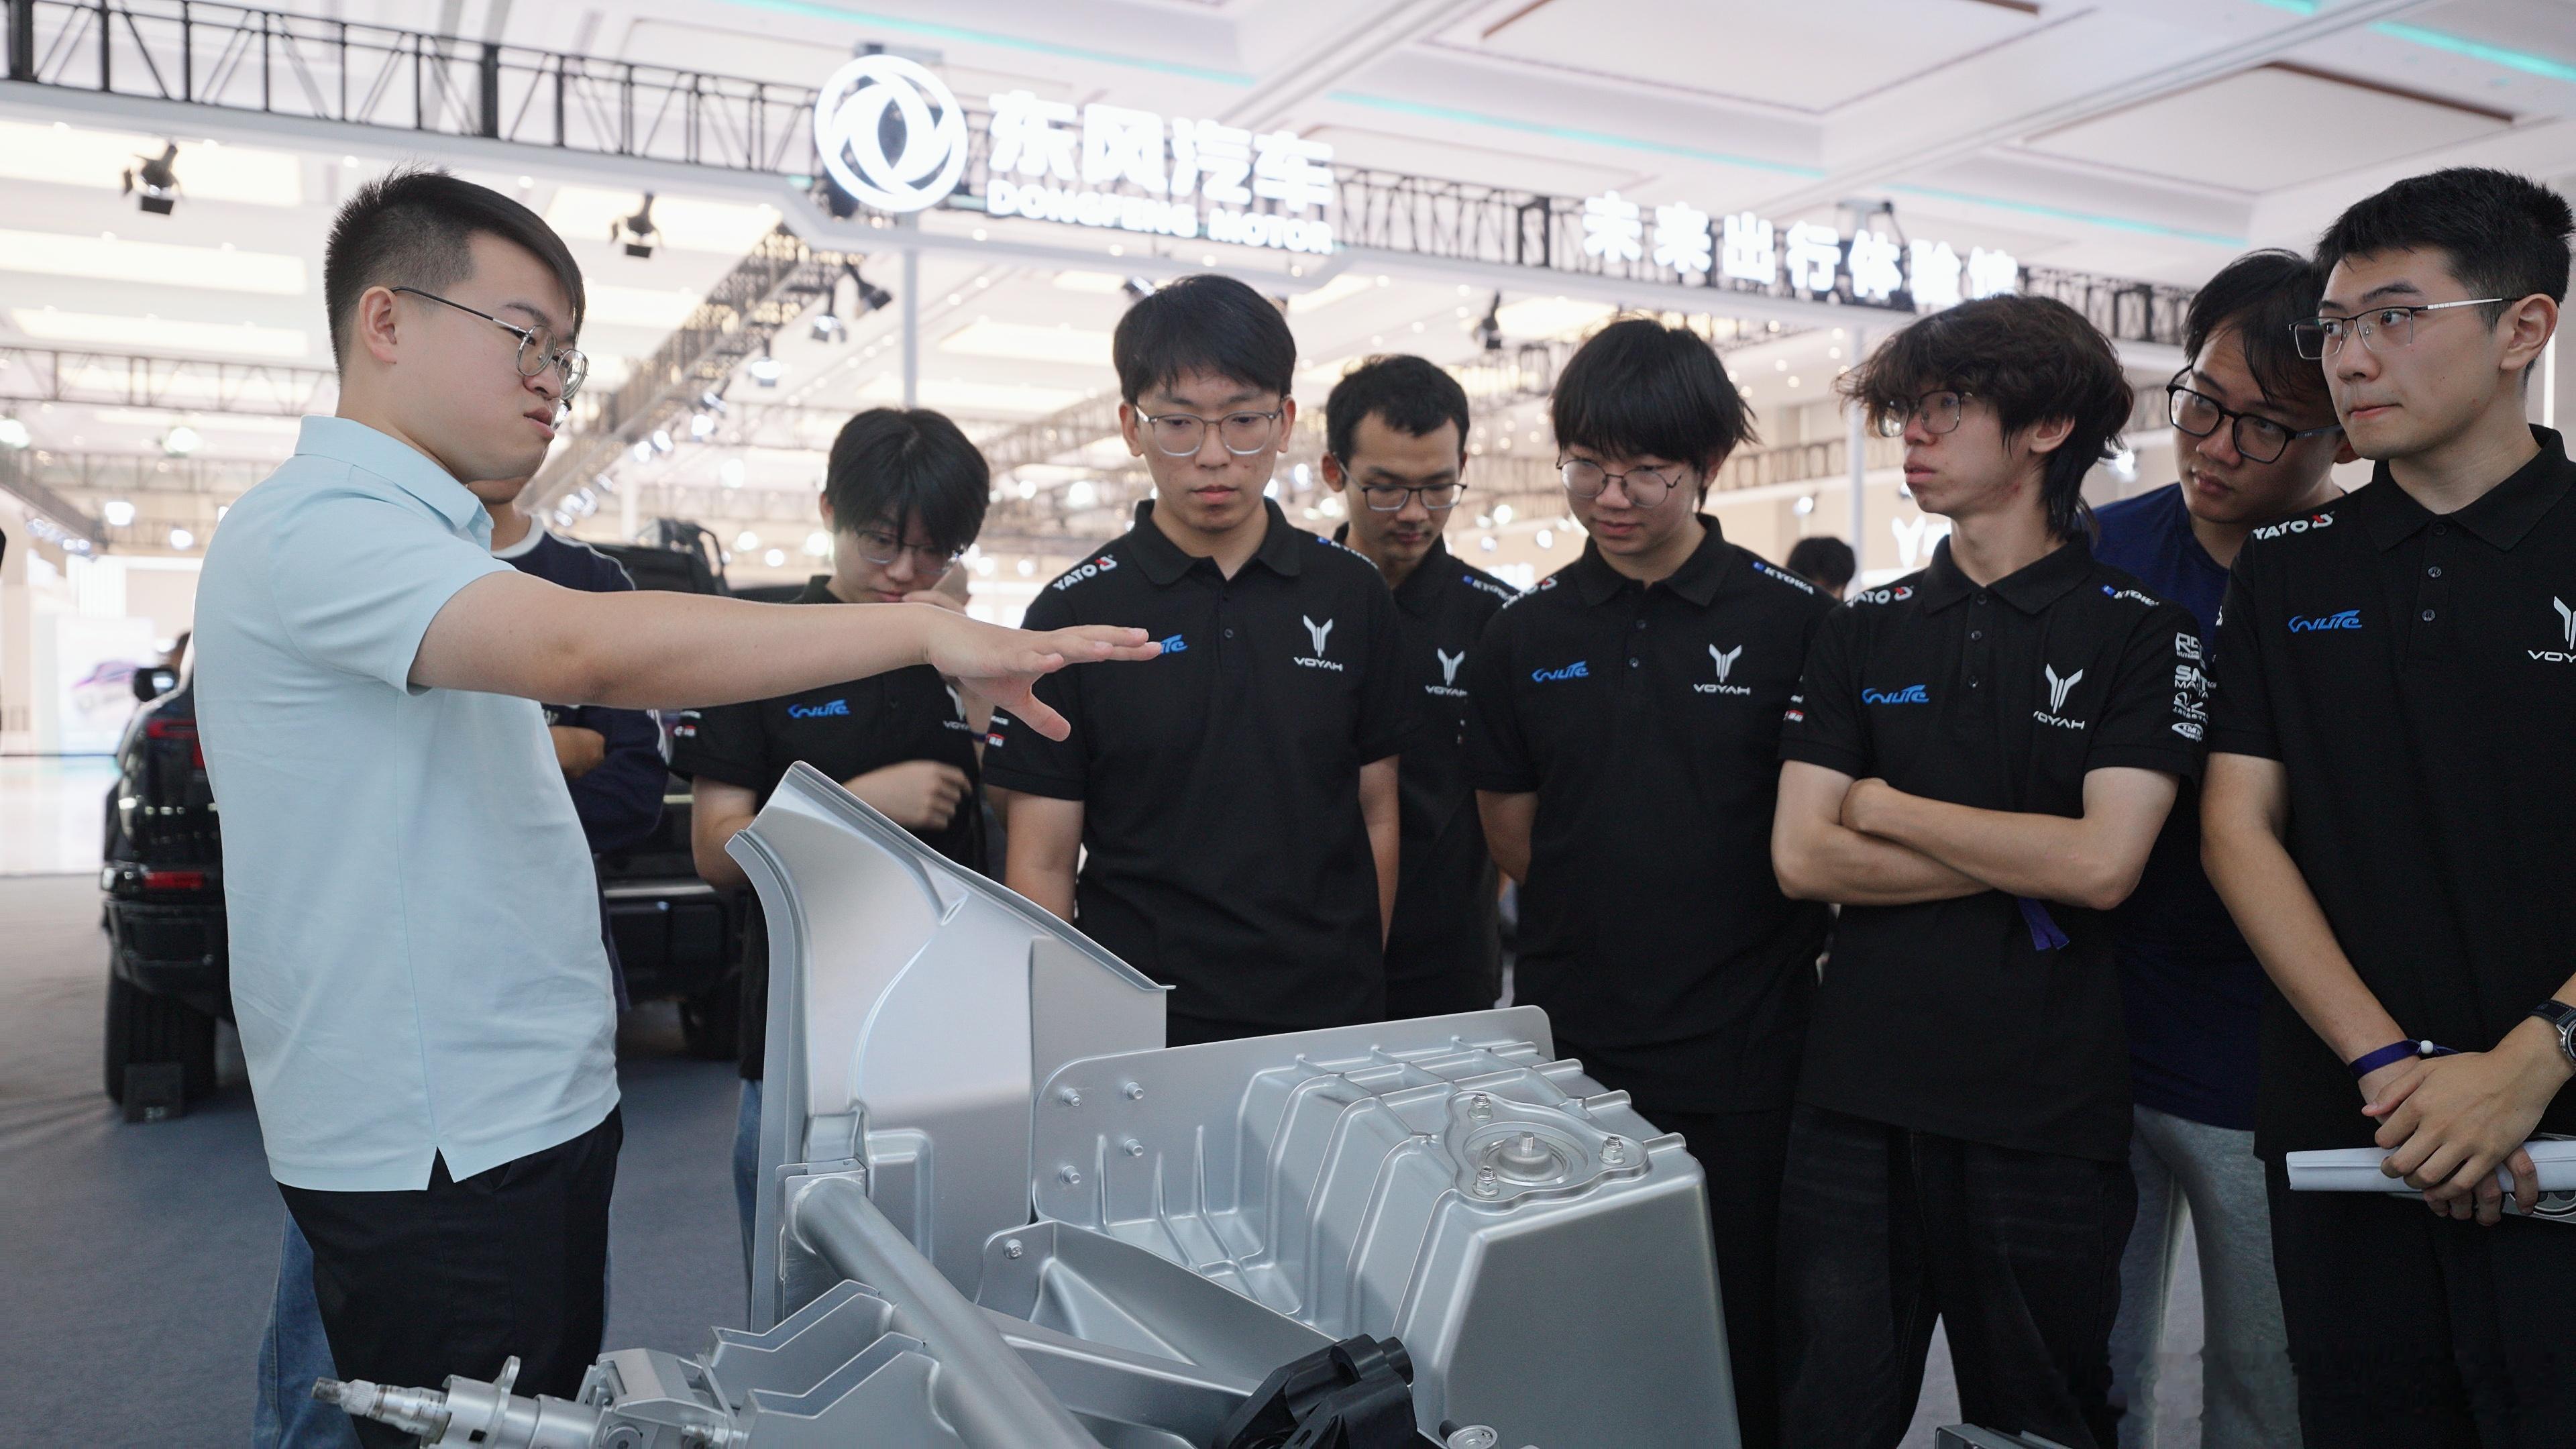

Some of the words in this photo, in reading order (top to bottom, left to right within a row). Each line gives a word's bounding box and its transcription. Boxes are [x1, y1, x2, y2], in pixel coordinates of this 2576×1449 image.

[987, 89, 1334, 213] 东风汽车
[986, 178, 1198, 238] DONGFENG
[1208, 207, 1334, 255] MOTOR
[2253, 519, 2309, 540] YATO
[1053, 564, 1097, 590] YATO
[1293, 657, 1343, 672] VOYAH
[1425, 685, 1468, 697] VOYAH
[1693, 684, 1751, 695] VOYAH
